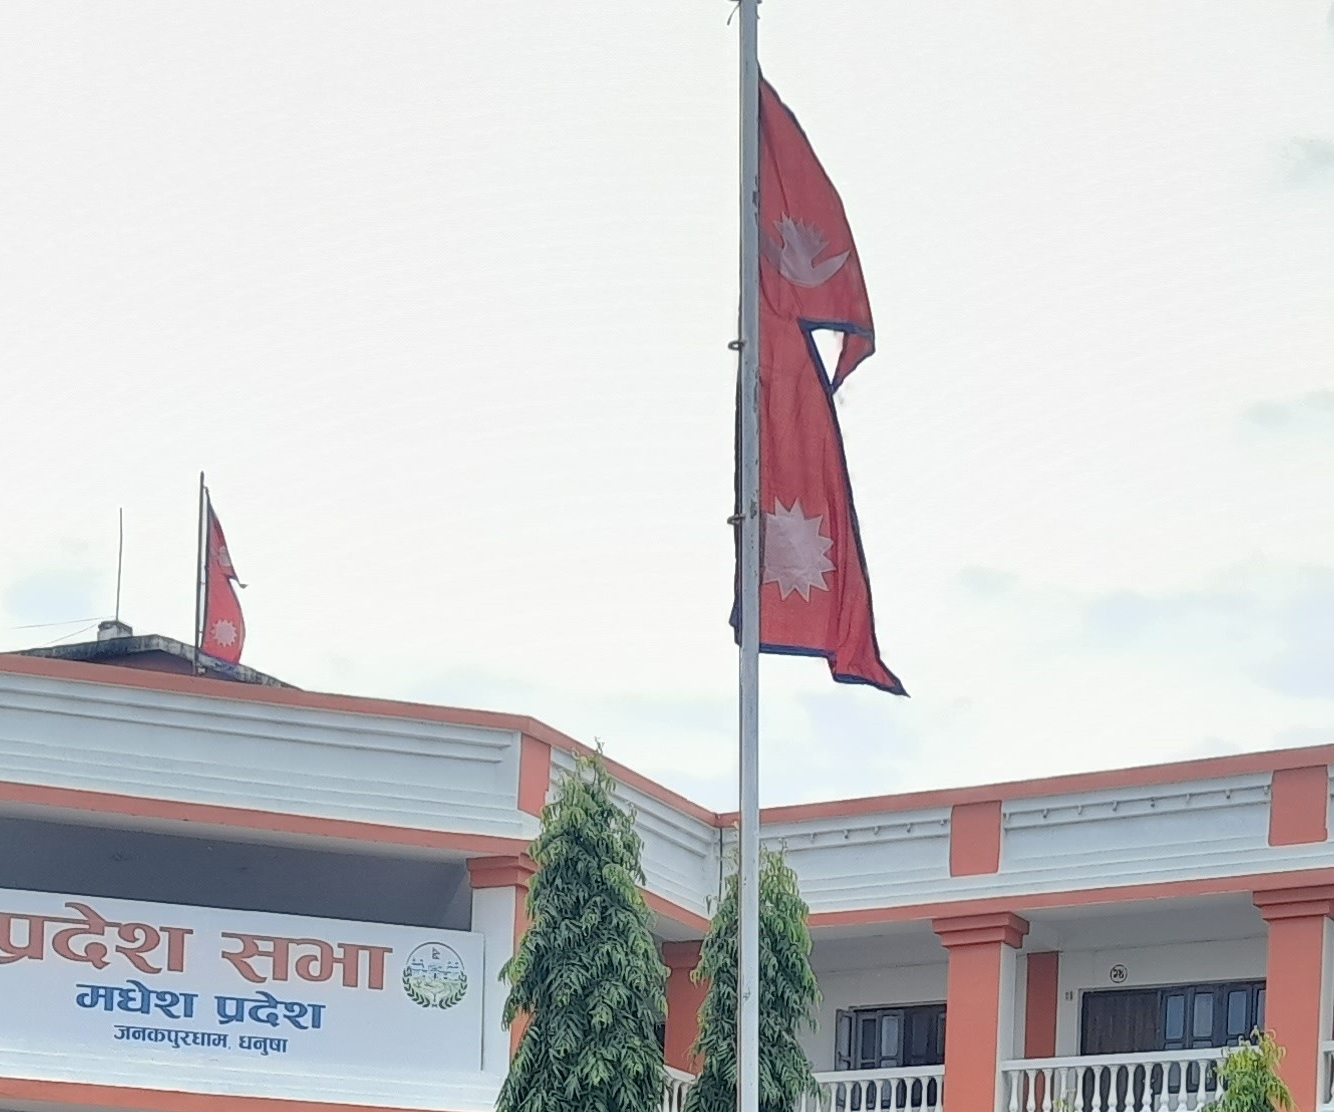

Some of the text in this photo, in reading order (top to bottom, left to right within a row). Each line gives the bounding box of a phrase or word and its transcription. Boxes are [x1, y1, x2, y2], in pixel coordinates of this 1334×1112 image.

[221, 931, 393, 990] सभा
[76, 980, 326, 1030] मधेश प्रदेश
[239, 1035, 288, 1056] धनुषा
